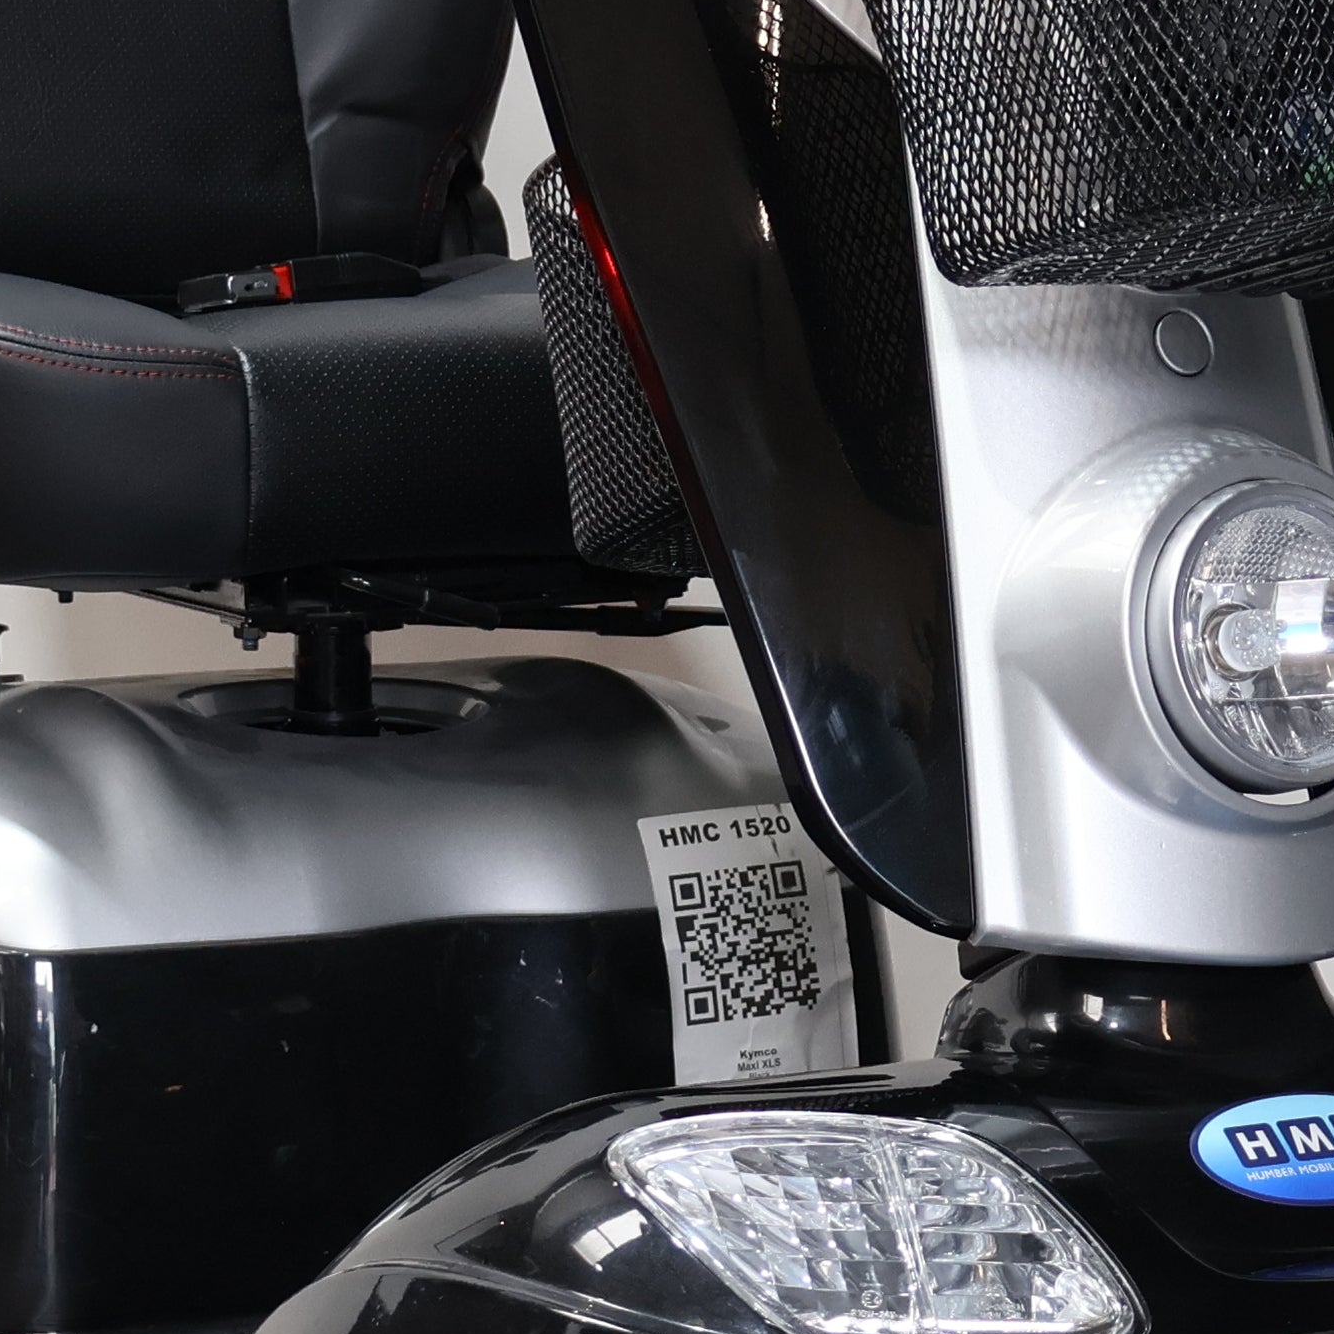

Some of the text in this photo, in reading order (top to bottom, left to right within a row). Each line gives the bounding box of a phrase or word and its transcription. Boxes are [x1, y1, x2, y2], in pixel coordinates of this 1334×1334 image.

[659, 815, 792, 848] HMC 1520
[739, 1048, 778, 1060] Kymco
[738, 1057, 781, 1072] Maxi XLS
[1246, 1166, 1297, 1182] HUMBER
